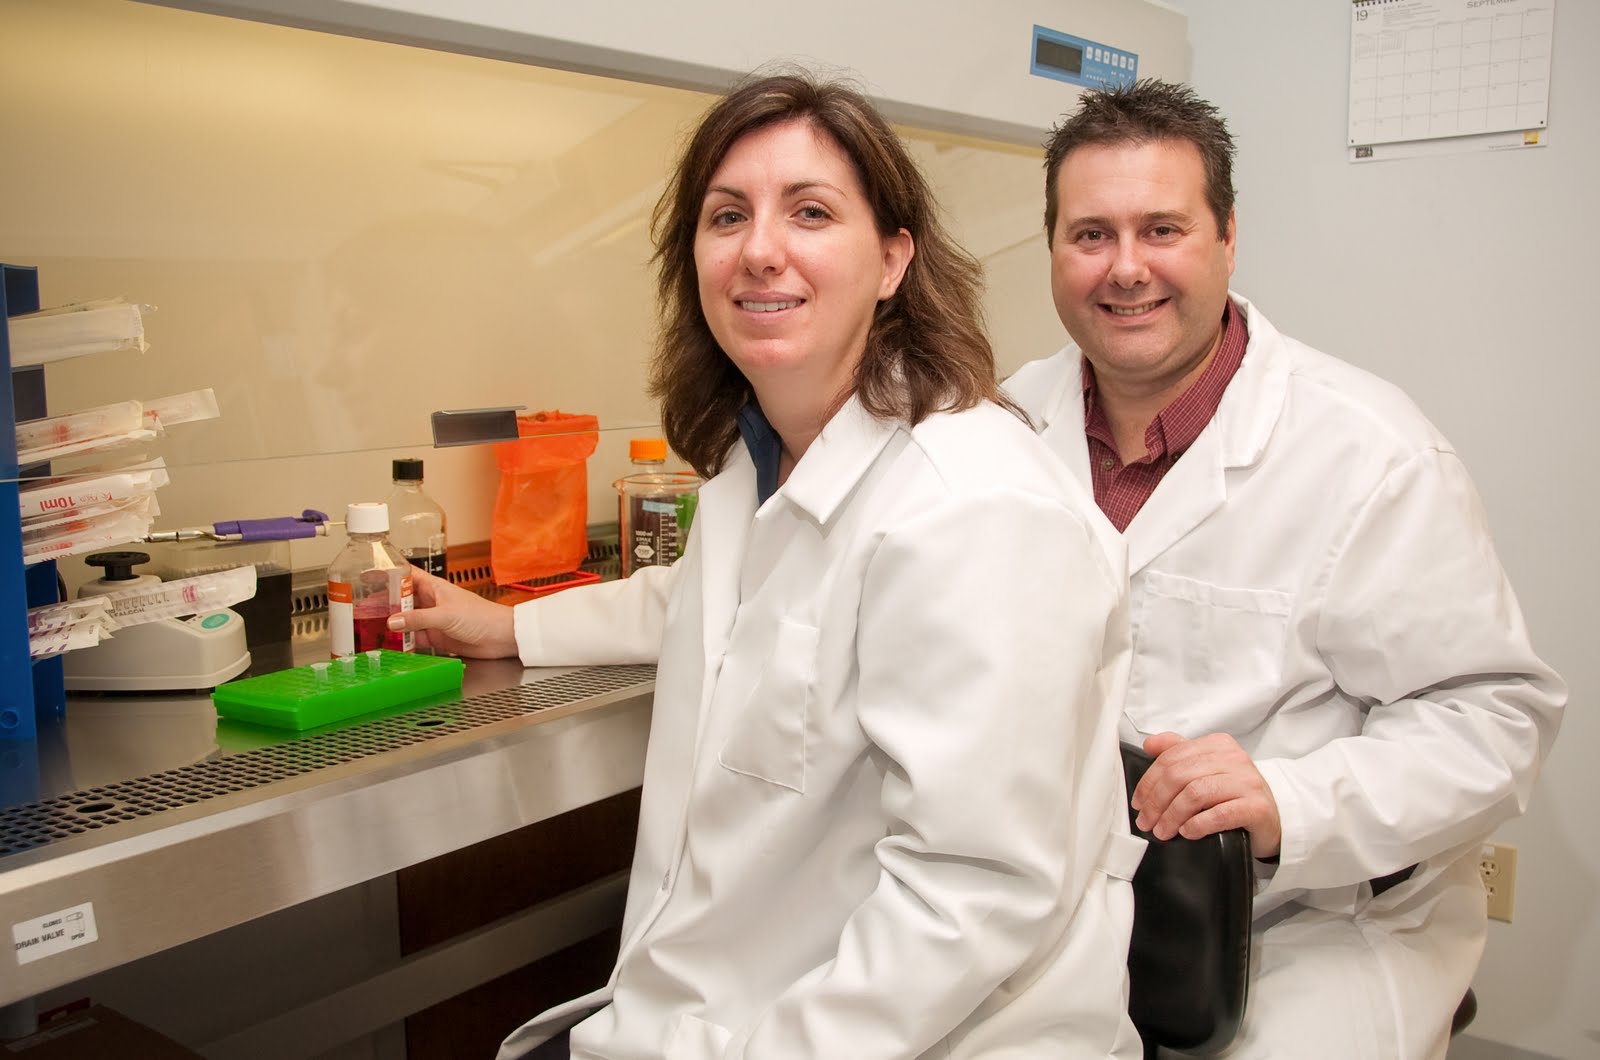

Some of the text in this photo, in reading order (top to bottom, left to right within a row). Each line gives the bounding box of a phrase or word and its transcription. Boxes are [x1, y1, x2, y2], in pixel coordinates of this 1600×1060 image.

[1356, 10, 1368, 21] 19
[39, 496, 76, 511] 10ml
[15, 928, 65, 950] DRAIN VALVE
[71, 932, 86, 941] OPEN
